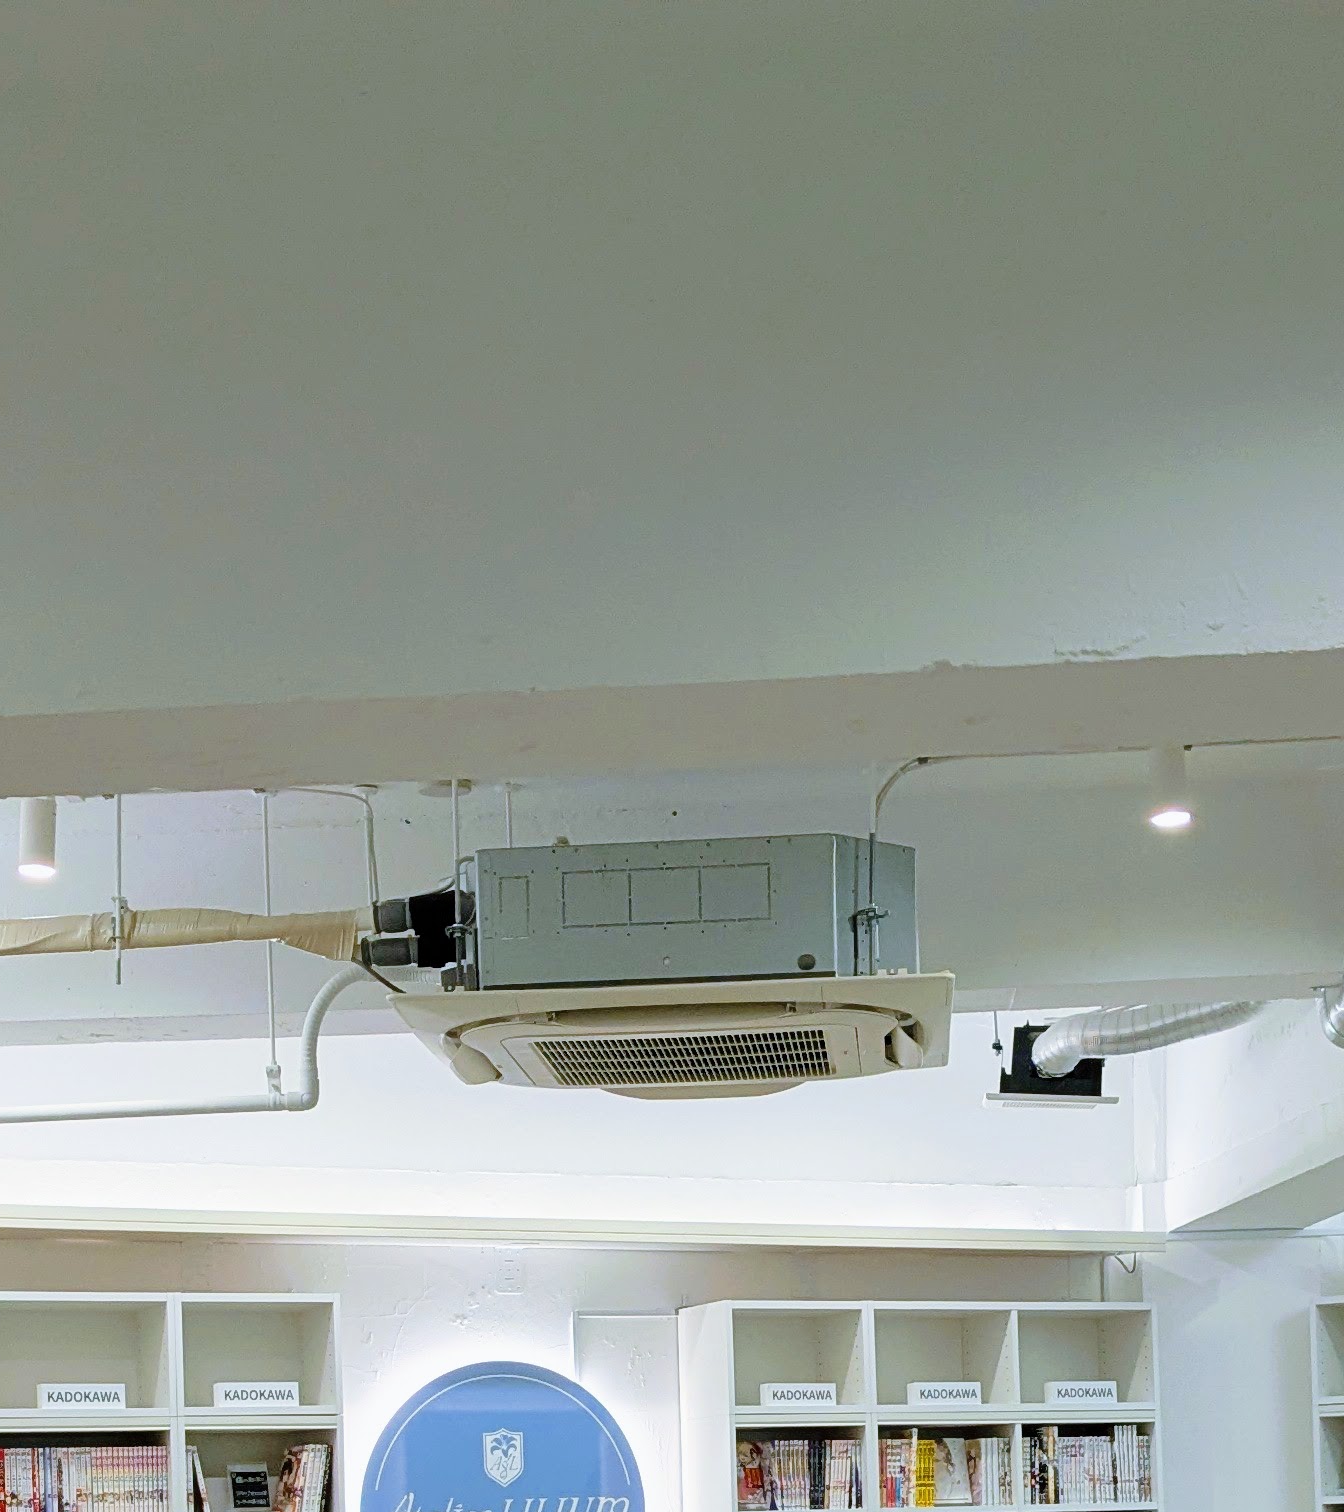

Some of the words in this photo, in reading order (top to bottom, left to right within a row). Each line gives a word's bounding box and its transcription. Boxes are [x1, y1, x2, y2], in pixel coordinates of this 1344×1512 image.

[47, 1391, 121, 1403] KADOKAWA
[224, 1389, 295, 1401] KADOKAWA
[772, 1389, 833, 1401] KADOKAWA
[919, 1388, 978, 1400] KADOKAWA
[1056, 1387, 1114, 1399] KADOKAWA
